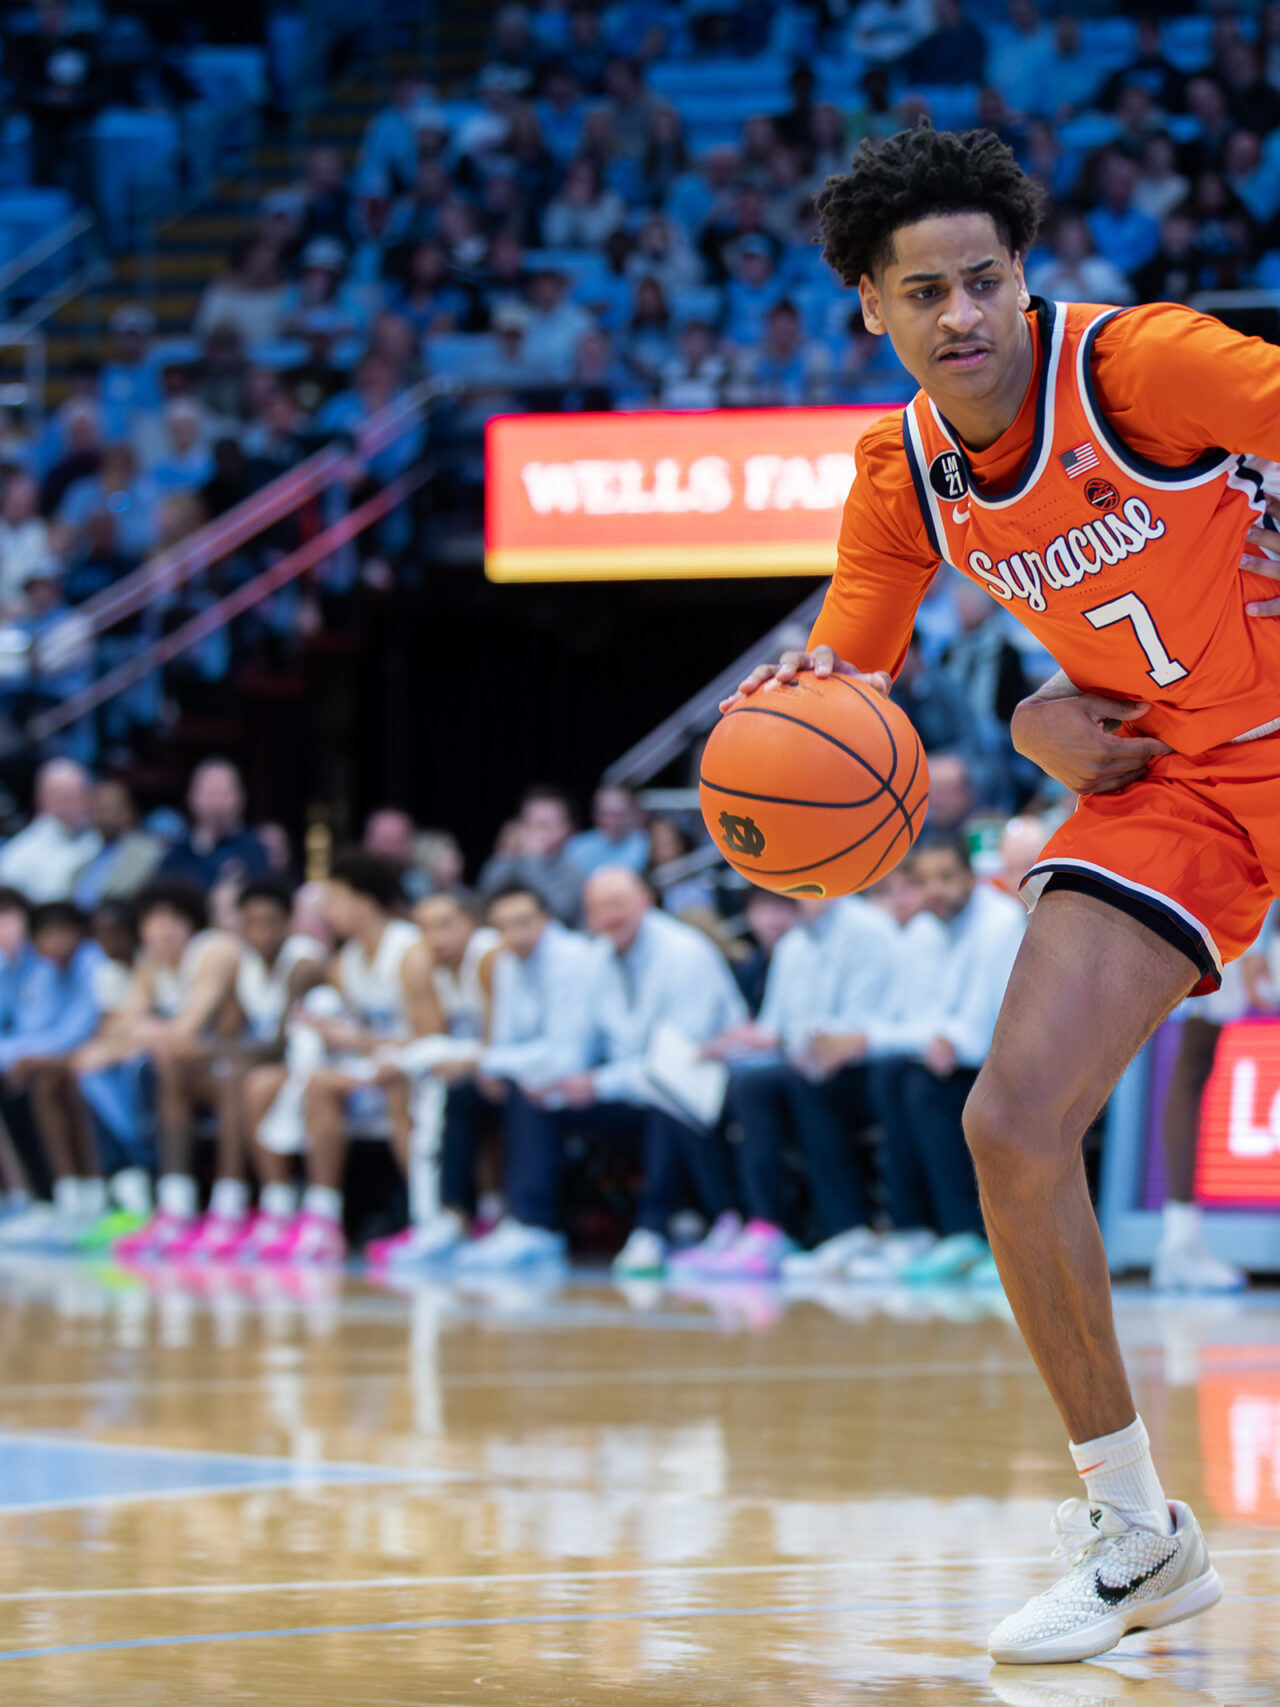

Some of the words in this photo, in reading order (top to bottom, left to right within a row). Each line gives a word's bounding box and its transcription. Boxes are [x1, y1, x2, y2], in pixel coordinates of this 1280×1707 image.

[522, 455, 732, 514] WELLS
[744, 452, 858, 511] FAR
[941, 455, 959, 474] LM
[945, 471, 964, 497] 21
[968, 497, 1166, 612] Syracuse
[1081, 590, 1190, 688] 7
